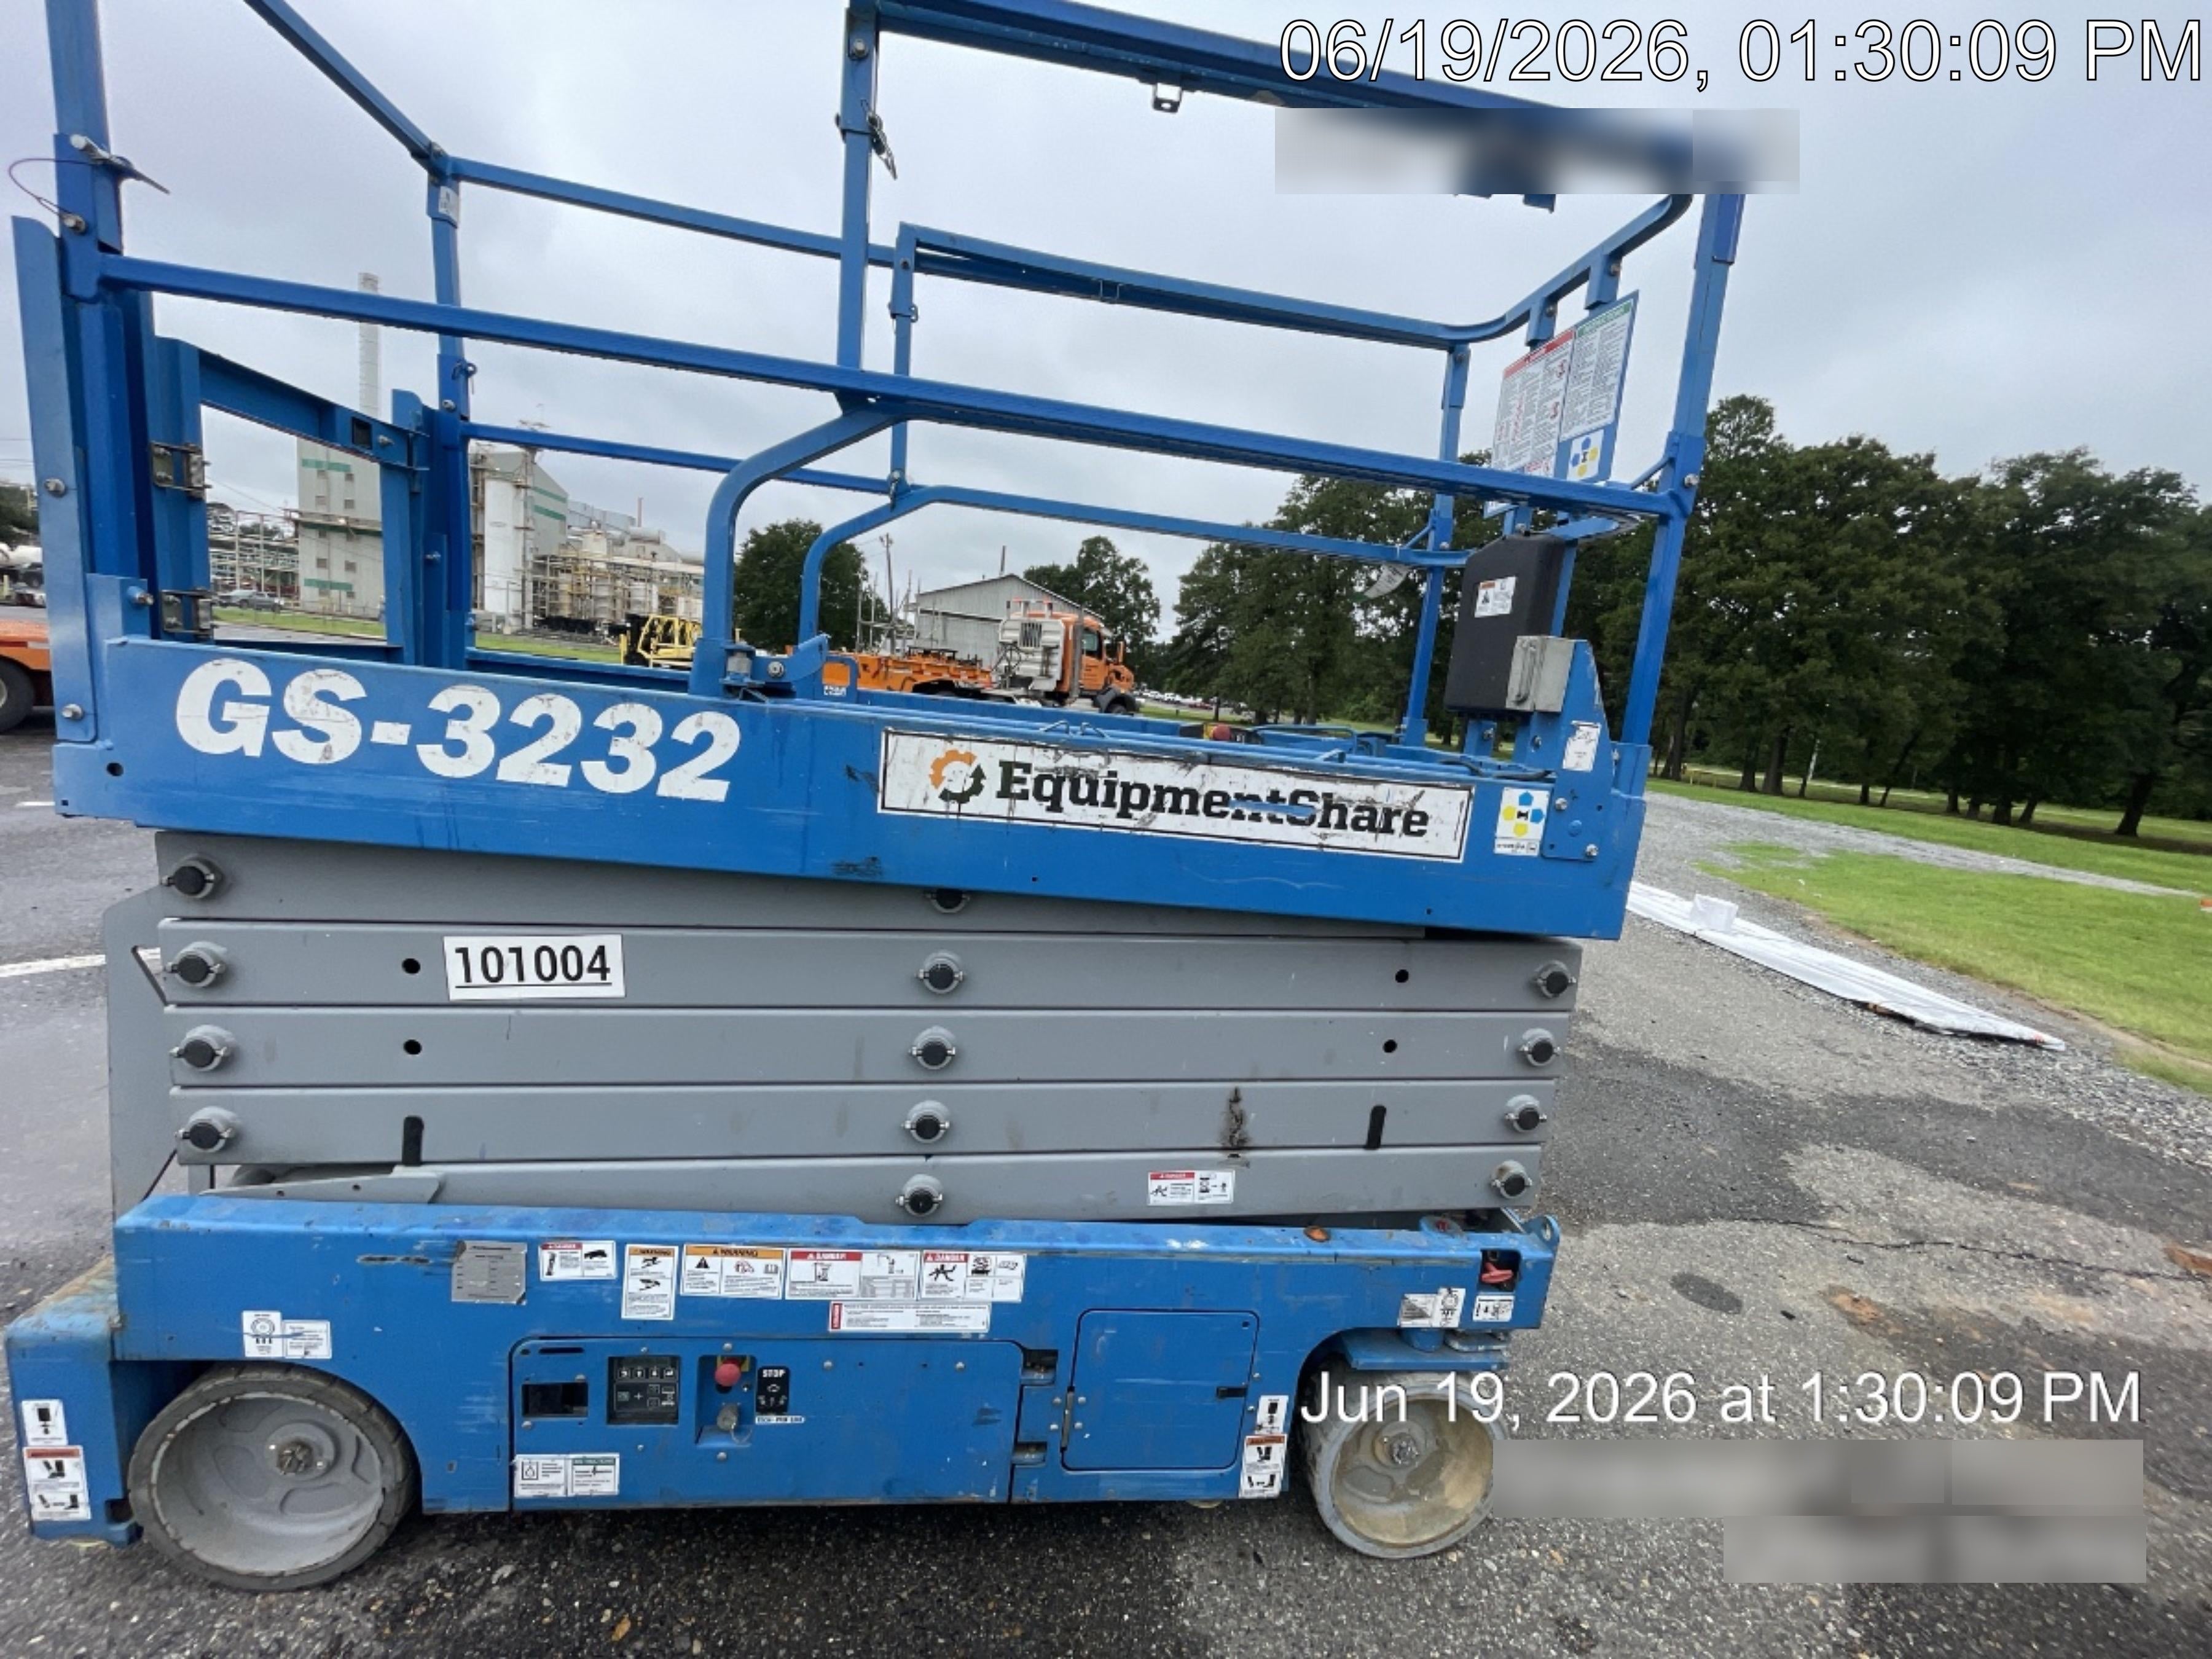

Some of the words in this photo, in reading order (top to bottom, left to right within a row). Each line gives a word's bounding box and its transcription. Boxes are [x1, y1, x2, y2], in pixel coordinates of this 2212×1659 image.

[176, 658, 751, 802] GS-3232
[996, 760, 1430, 837] EquipmentShare
[455, 945, 610, 983] 101004
[763, 1369, 786, 1378] STOP
